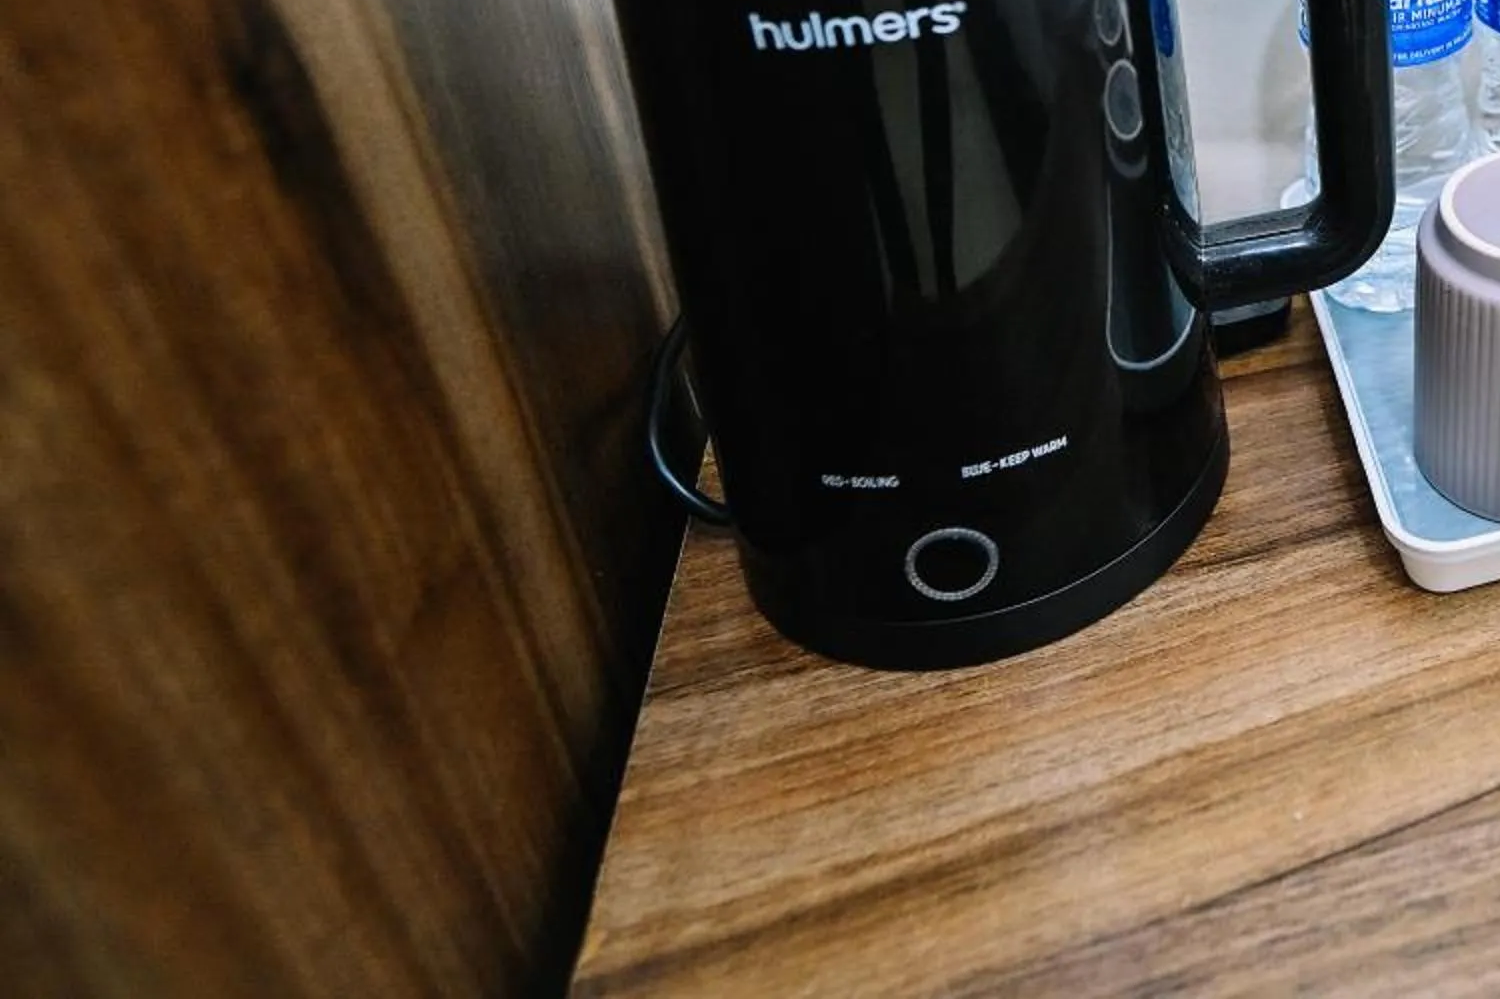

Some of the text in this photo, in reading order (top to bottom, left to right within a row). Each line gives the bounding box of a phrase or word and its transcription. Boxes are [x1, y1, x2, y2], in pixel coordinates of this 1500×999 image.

[749, 1, 966, 51] hulmers
[1392, 12, 1405, 24] IR
[1031, 435, 1068, 458] WARM
